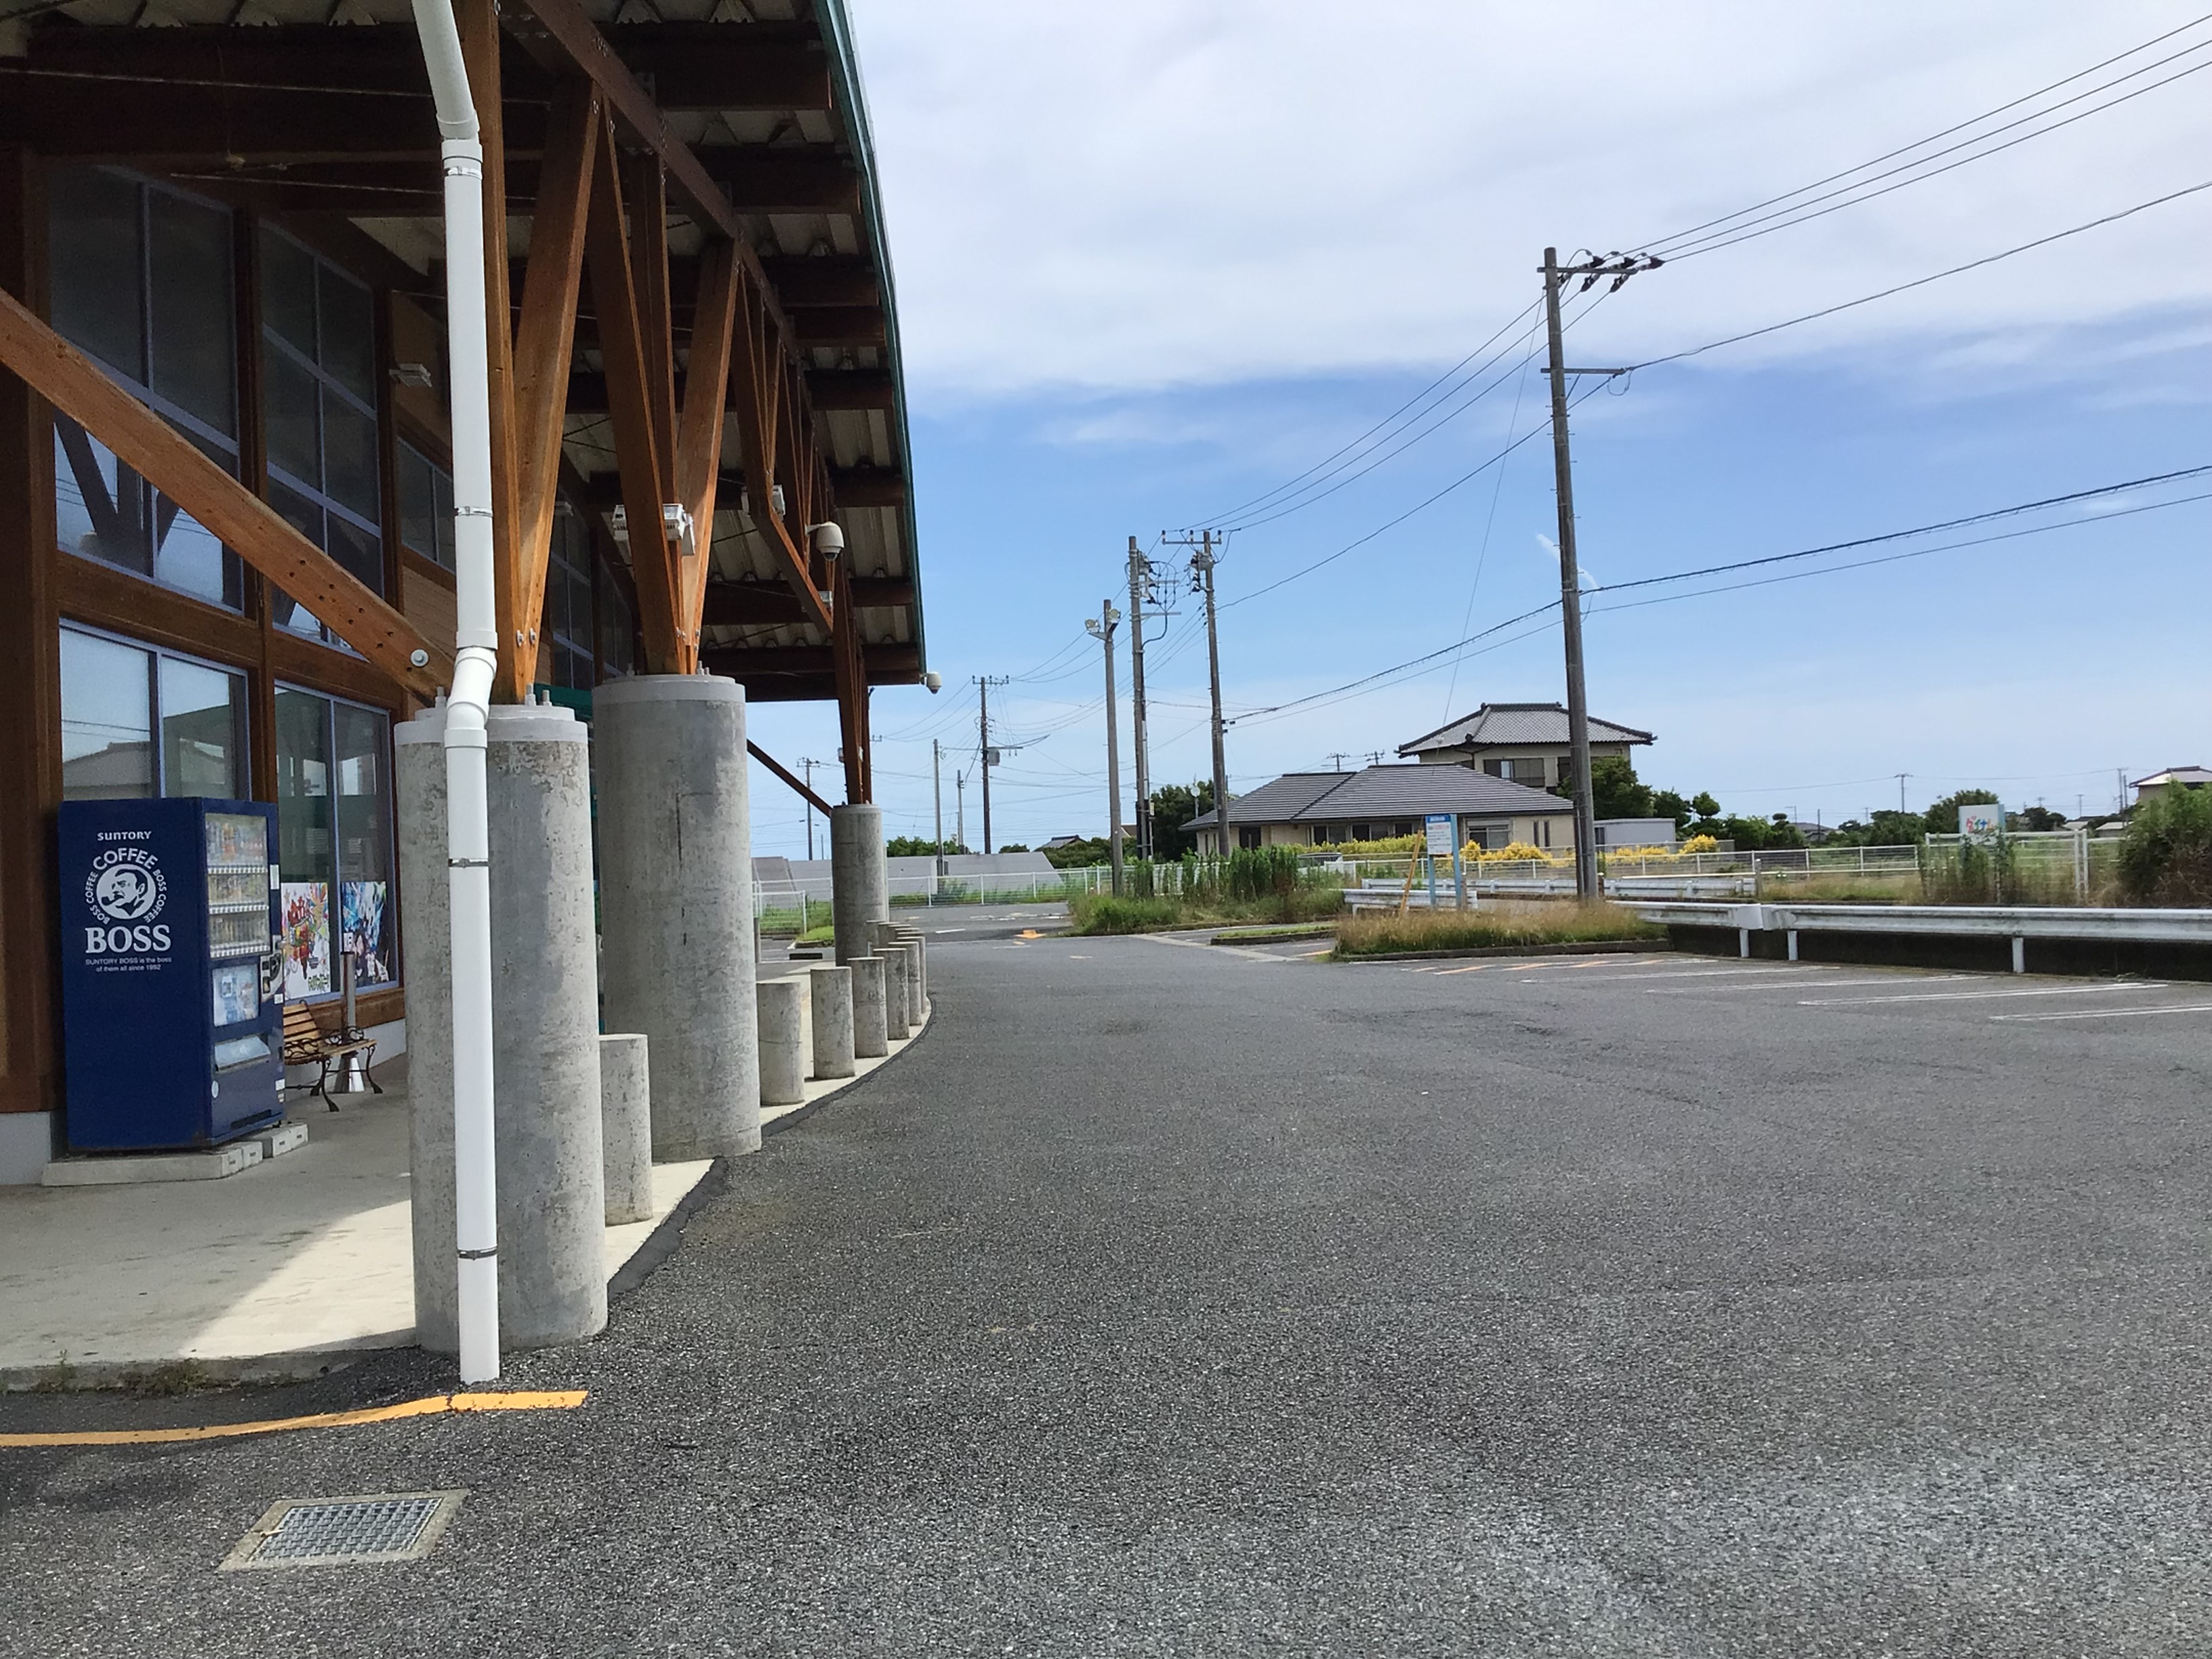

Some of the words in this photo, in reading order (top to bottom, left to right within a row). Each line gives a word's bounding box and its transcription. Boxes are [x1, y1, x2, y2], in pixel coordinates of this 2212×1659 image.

[97, 831, 152, 841] SUNTORY
[93, 847, 158, 870] COFFEE
[85, 871, 98, 903] COFFEE
[152, 869, 167, 891] BOSS
[89, 904, 110, 924] BOSS
[144, 894, 167, 923] COFFEE
[85, 924, 171, 954] BOSS
